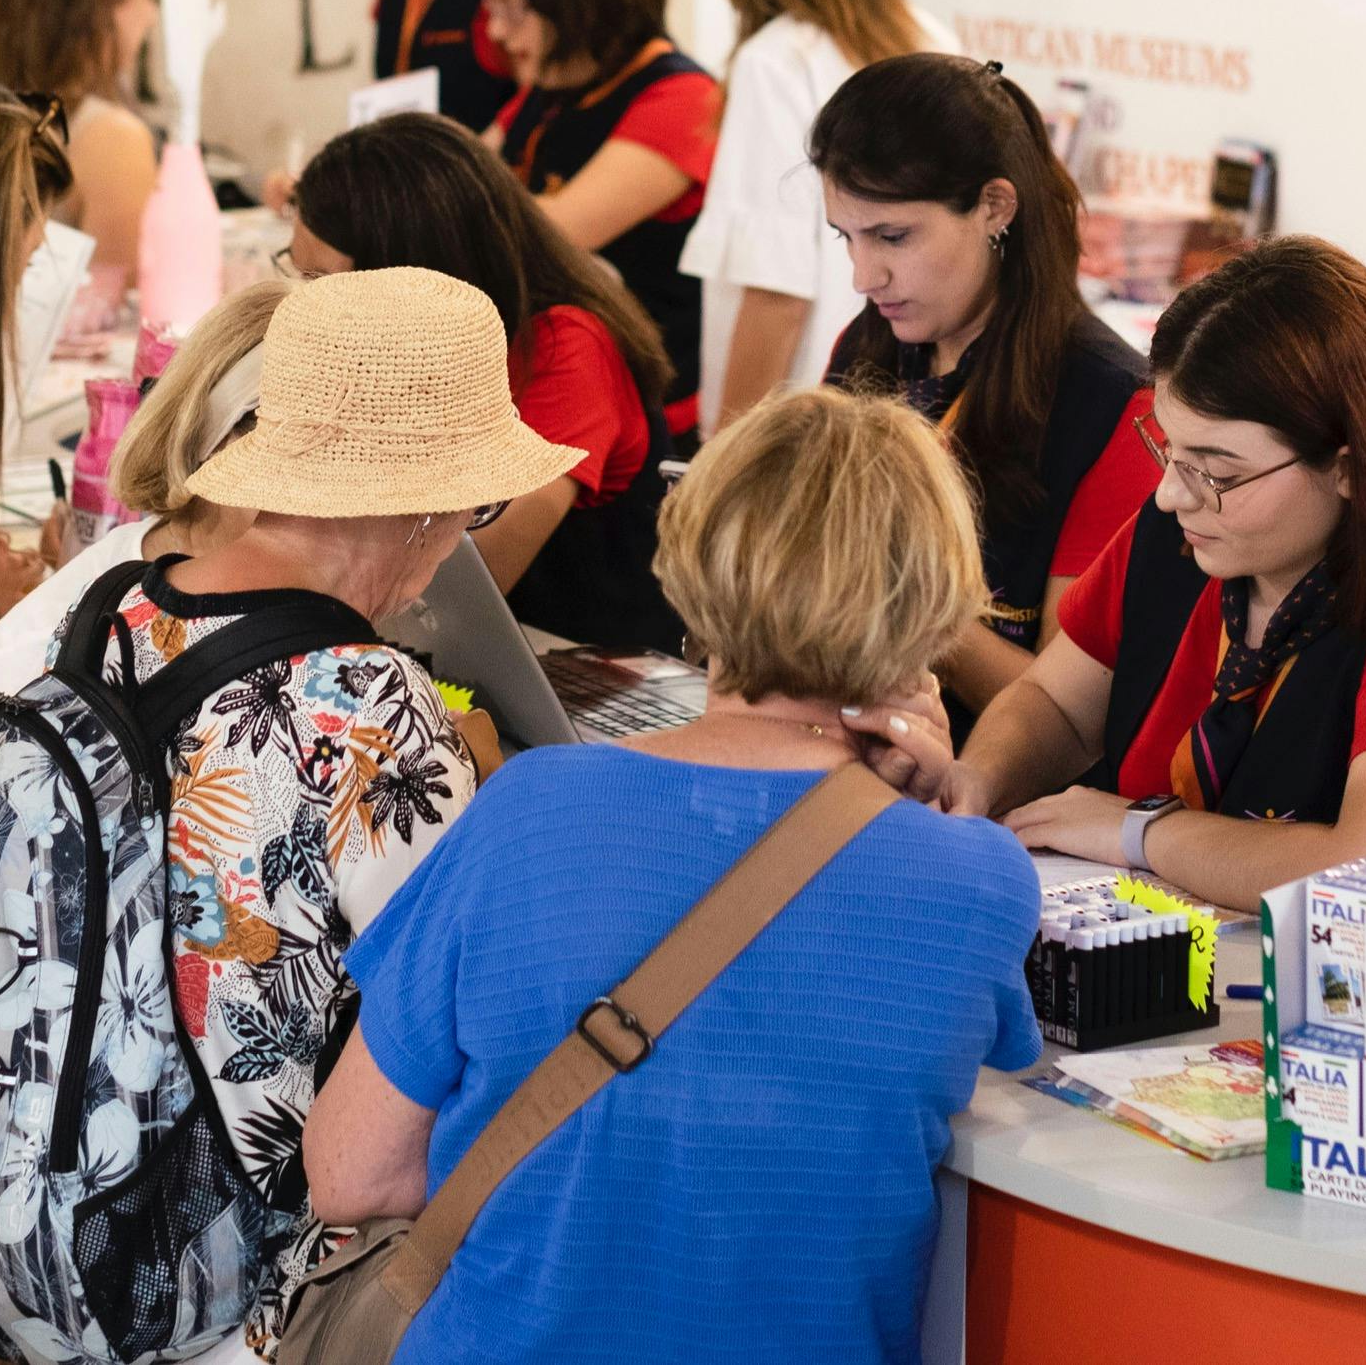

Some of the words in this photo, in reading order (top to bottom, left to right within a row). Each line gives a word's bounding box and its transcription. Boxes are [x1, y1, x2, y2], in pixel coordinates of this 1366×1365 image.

[1092, 30, 1252, 93] MUSEUMS
[1312, 898, 1366, 925] ITALI
[1311, 924, 1333, 946] 54
[1281, 1058, 1348, 1088] TALIA
[1307, 1169, 1349, 1187] CARTE
